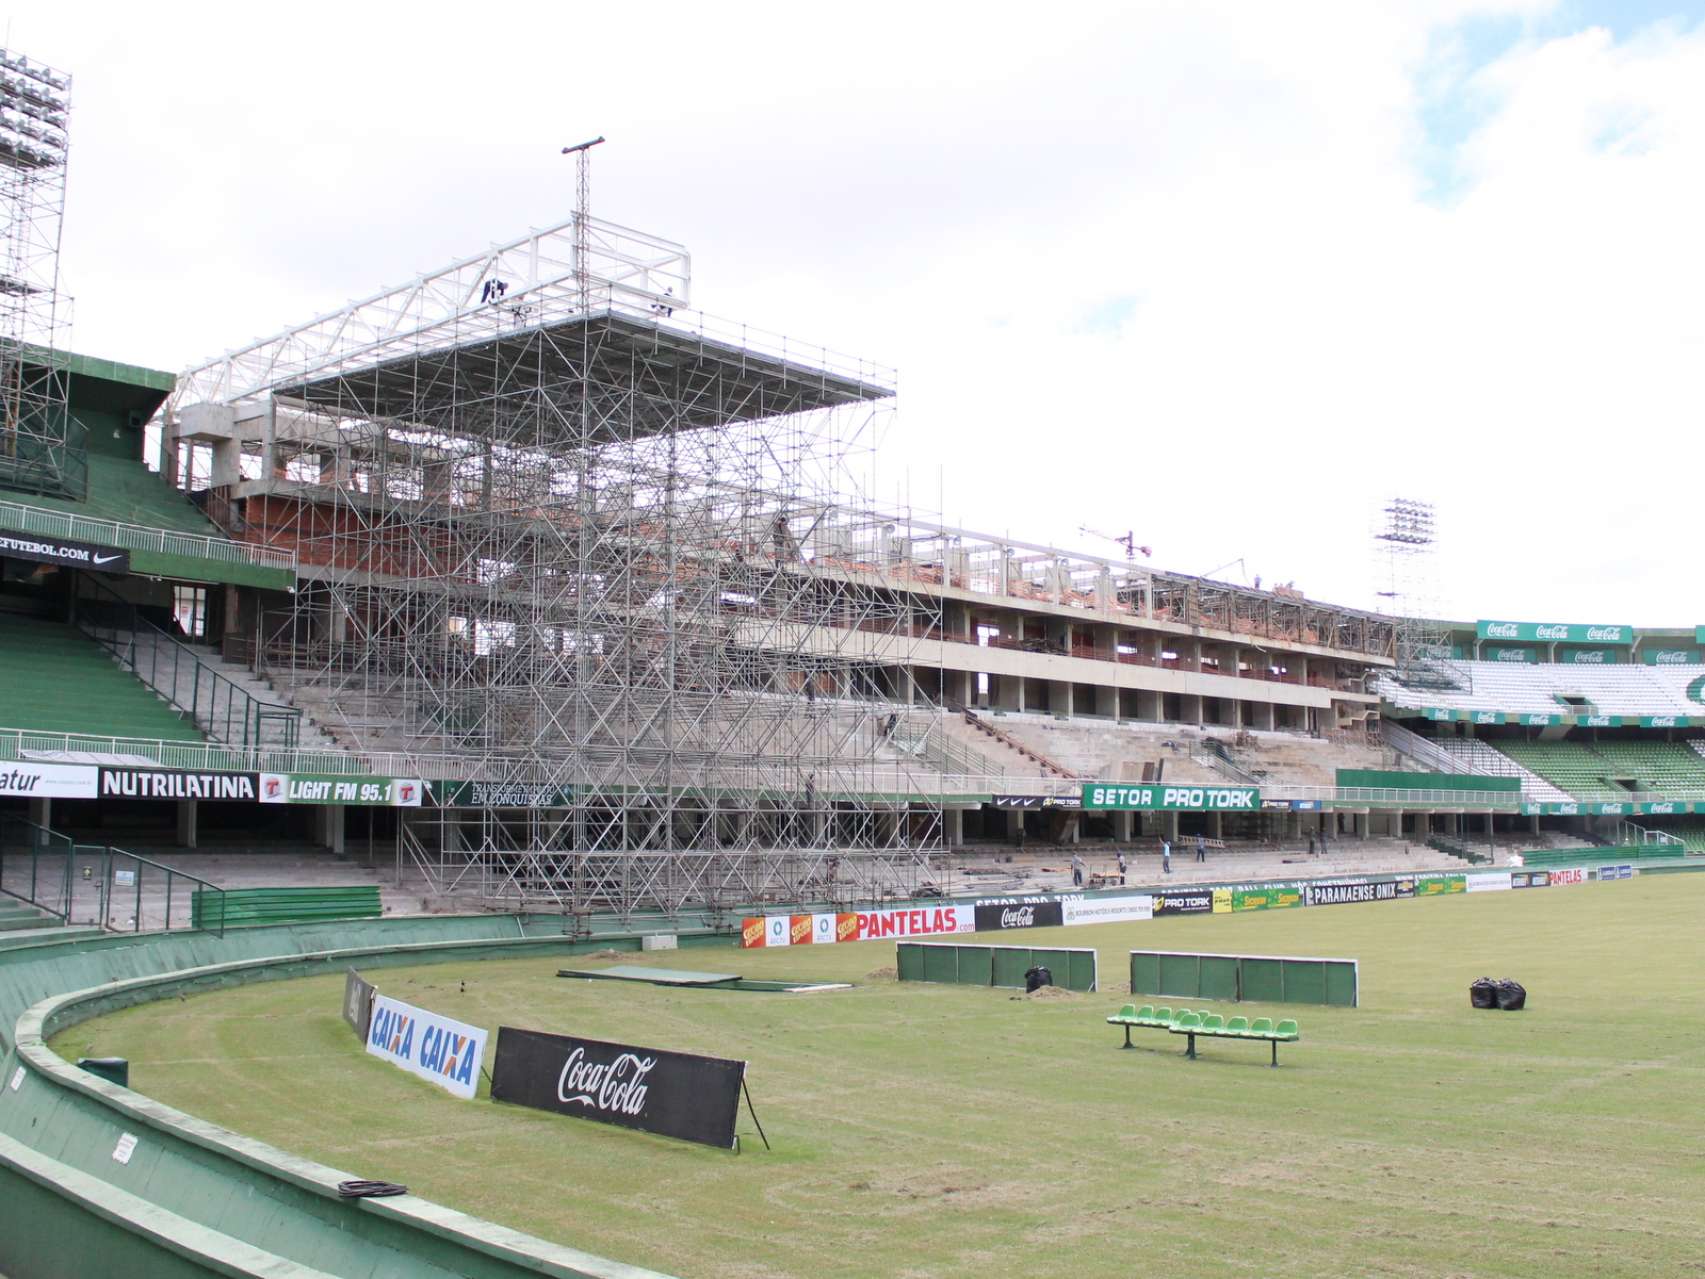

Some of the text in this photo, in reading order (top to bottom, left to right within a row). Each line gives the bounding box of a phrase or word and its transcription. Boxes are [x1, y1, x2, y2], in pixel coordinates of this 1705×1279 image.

[103, 771, 254, 798] NUTRILATINA
[289, 781, 392, 801] LIGHT FM 95.1
[1093, 788, 1254, 808] SETOR PRO TORK
[1164, 898, 1185, 908] PRO
[1185, 897, 1210, 907] TORK
[1315, 885, 1375, 904] PARANAENSE
[1377, 883, 1396, 899] ONIX
[857, 908, 957, 938] PANTELAS
[1001, 906, 1034, 928] Coca-Cola
[372, 1007, 477, 1086] CAIXA CAIXA
[557, 1047, 657, 1116] Coca-Cola
